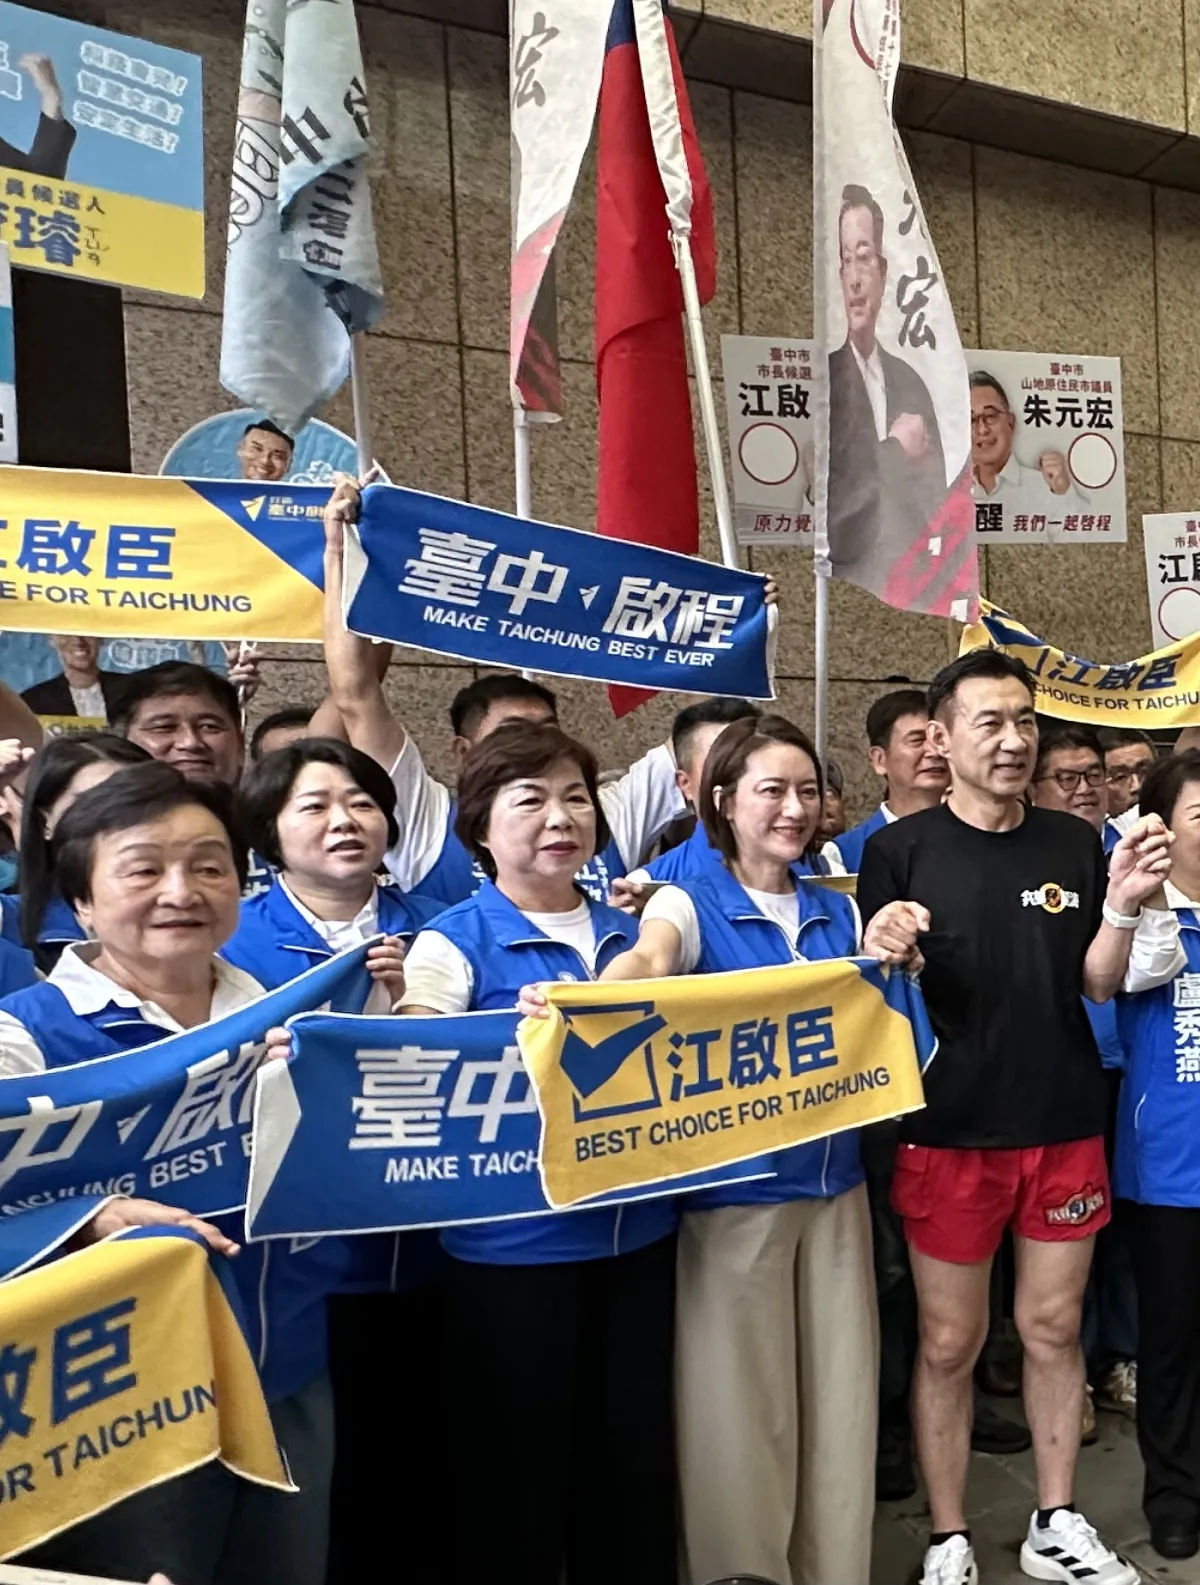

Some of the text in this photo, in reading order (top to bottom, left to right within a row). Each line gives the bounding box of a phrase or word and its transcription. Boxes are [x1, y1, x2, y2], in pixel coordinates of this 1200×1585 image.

[0, 201, 81, 267] 璿
[769, 347, 810, 362] 臺中市
[1050, 362, 1084, 376] 臺中市
[738, 382, 811, 419] 江啟
[1020, 377, 1113, 395] 山地原住民市議員
[1023, 394, 1114, 430] 朱元宏
[753, 513, 815, 533] 原力覺
[0, 518, 176, 580] 啟臣
[26, 583, 90, 606] FOR
[97, 589, 252, 613] TAICHUNG
[398, 527, 745, 650] 臺中 啟程
[422, 605, 715, 668] MAKE TAICHUNG BEST EVER
[1094, 697, 1129, 710] FOR
[668, 1006, 839, 1102] 江啟臣
[575, 1066, 891, 1163] BEST CHOICE FOR TAICHUNG
[150, 1141, 228, 1188] BEST
[385, 1157, 460, 1184] MAKE
